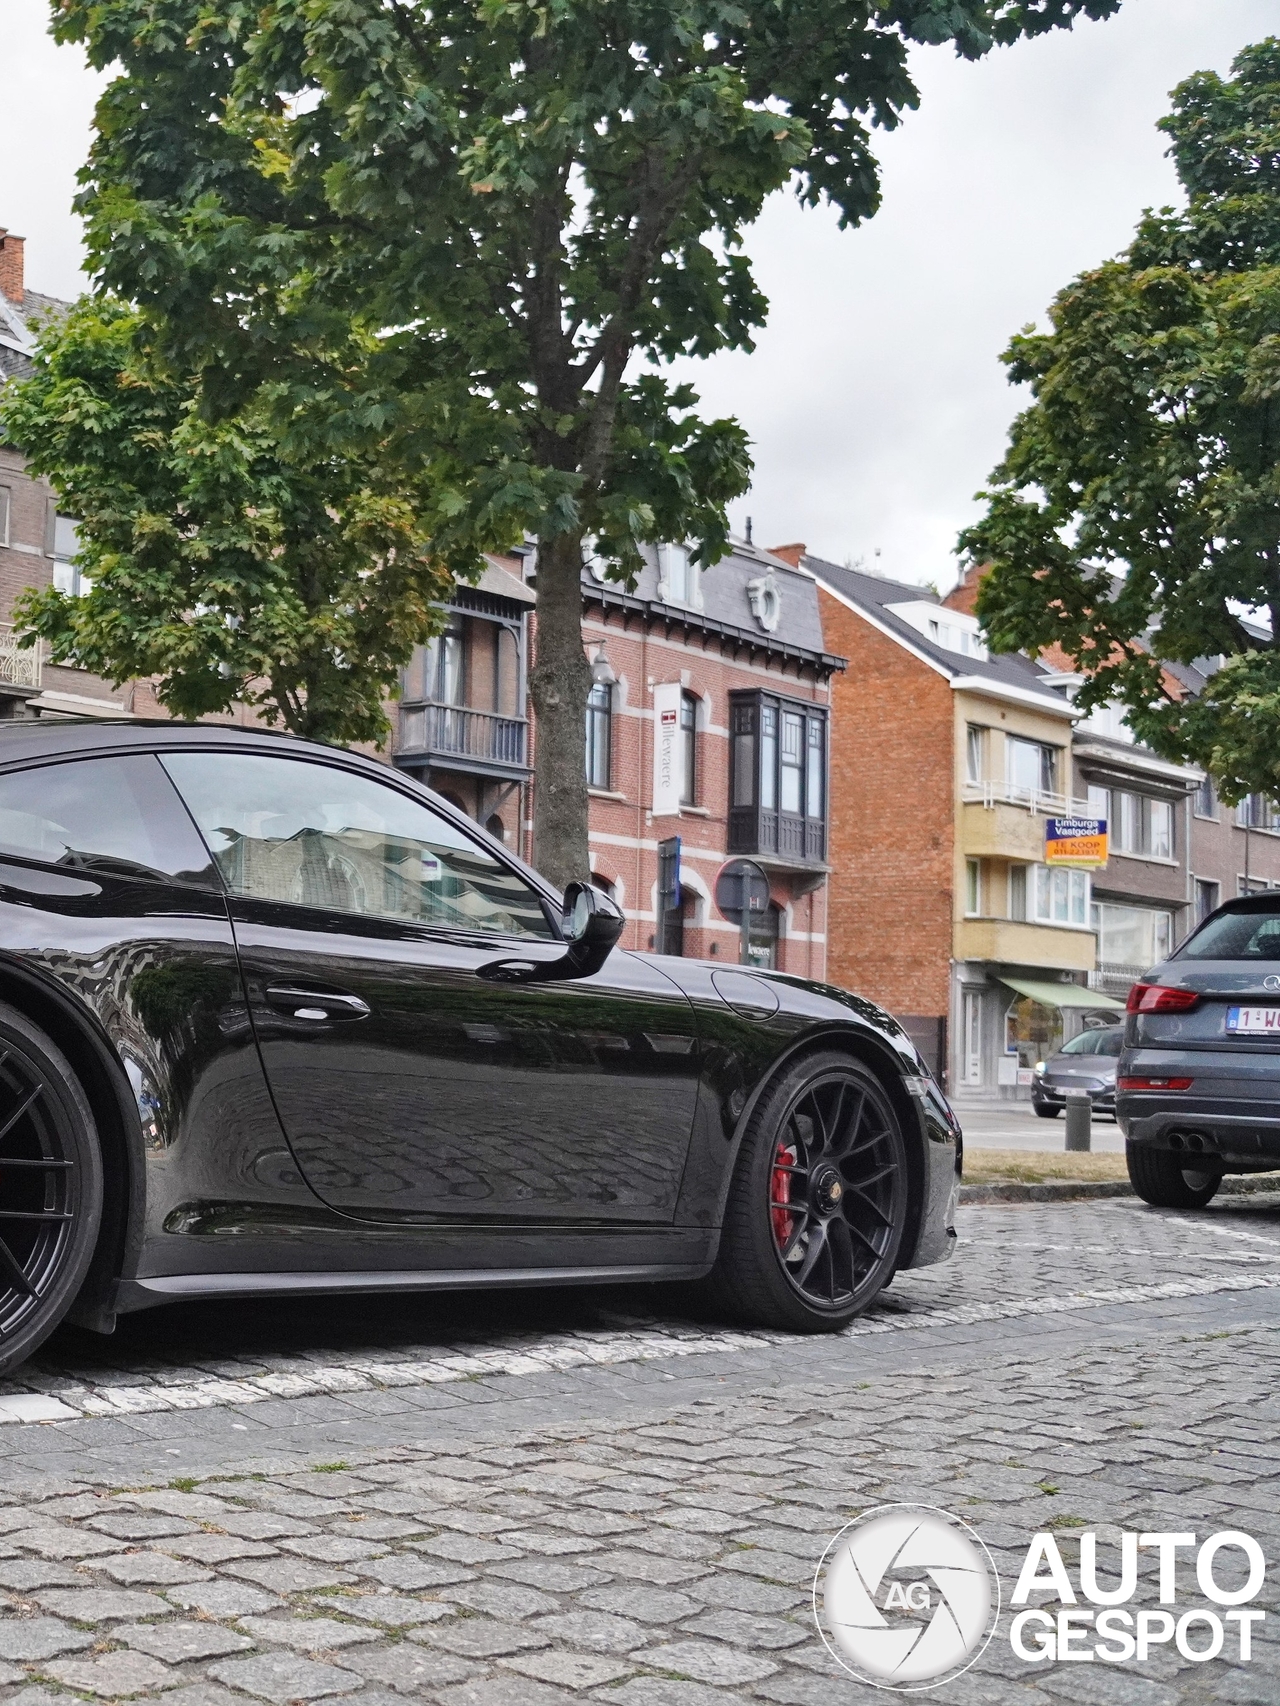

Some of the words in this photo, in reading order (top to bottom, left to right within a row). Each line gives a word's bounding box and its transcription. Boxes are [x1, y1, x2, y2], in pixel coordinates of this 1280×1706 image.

[1055, 819, 1099, 829] Limburgs
[1055, 827, 1098, 837] Vastgoed
[1071, 841, 1100, 849] KOOP
